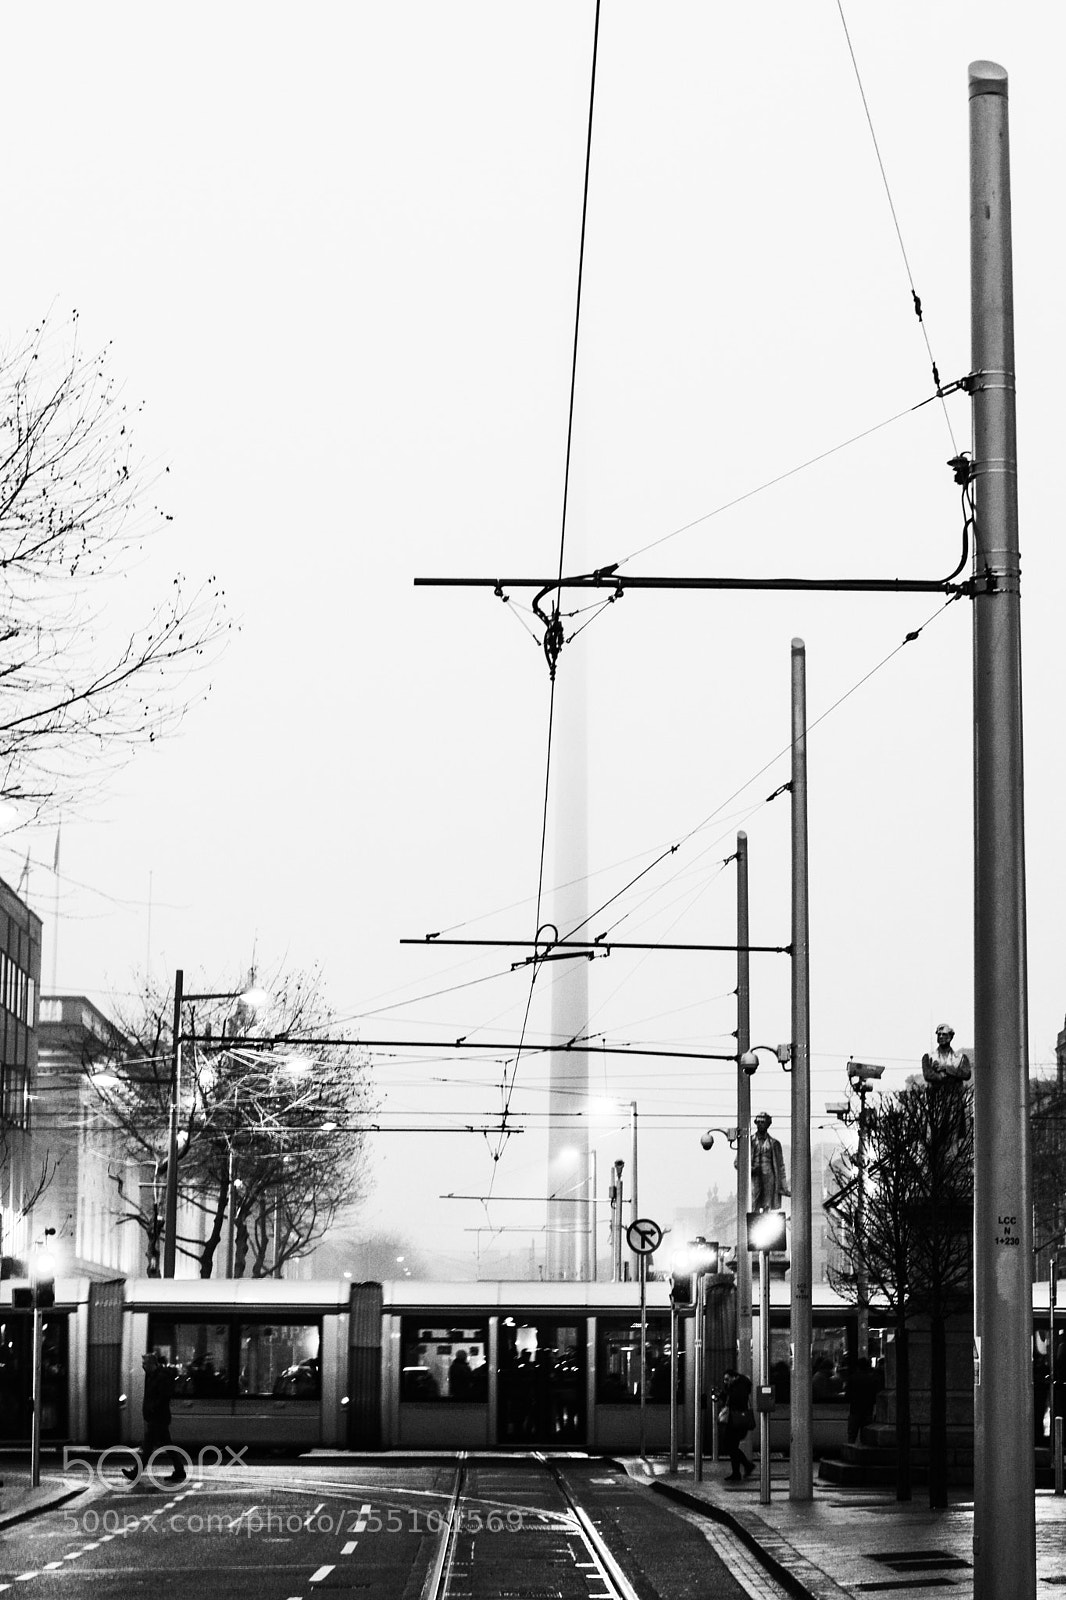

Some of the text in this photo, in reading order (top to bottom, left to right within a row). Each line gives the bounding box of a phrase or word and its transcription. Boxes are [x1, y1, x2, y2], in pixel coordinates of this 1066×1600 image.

[998, 1216, 1017, 1225] LCC
[1004, 1227, 1011, 1235] N
[995, 1237, 1020, 1246] 1+230
